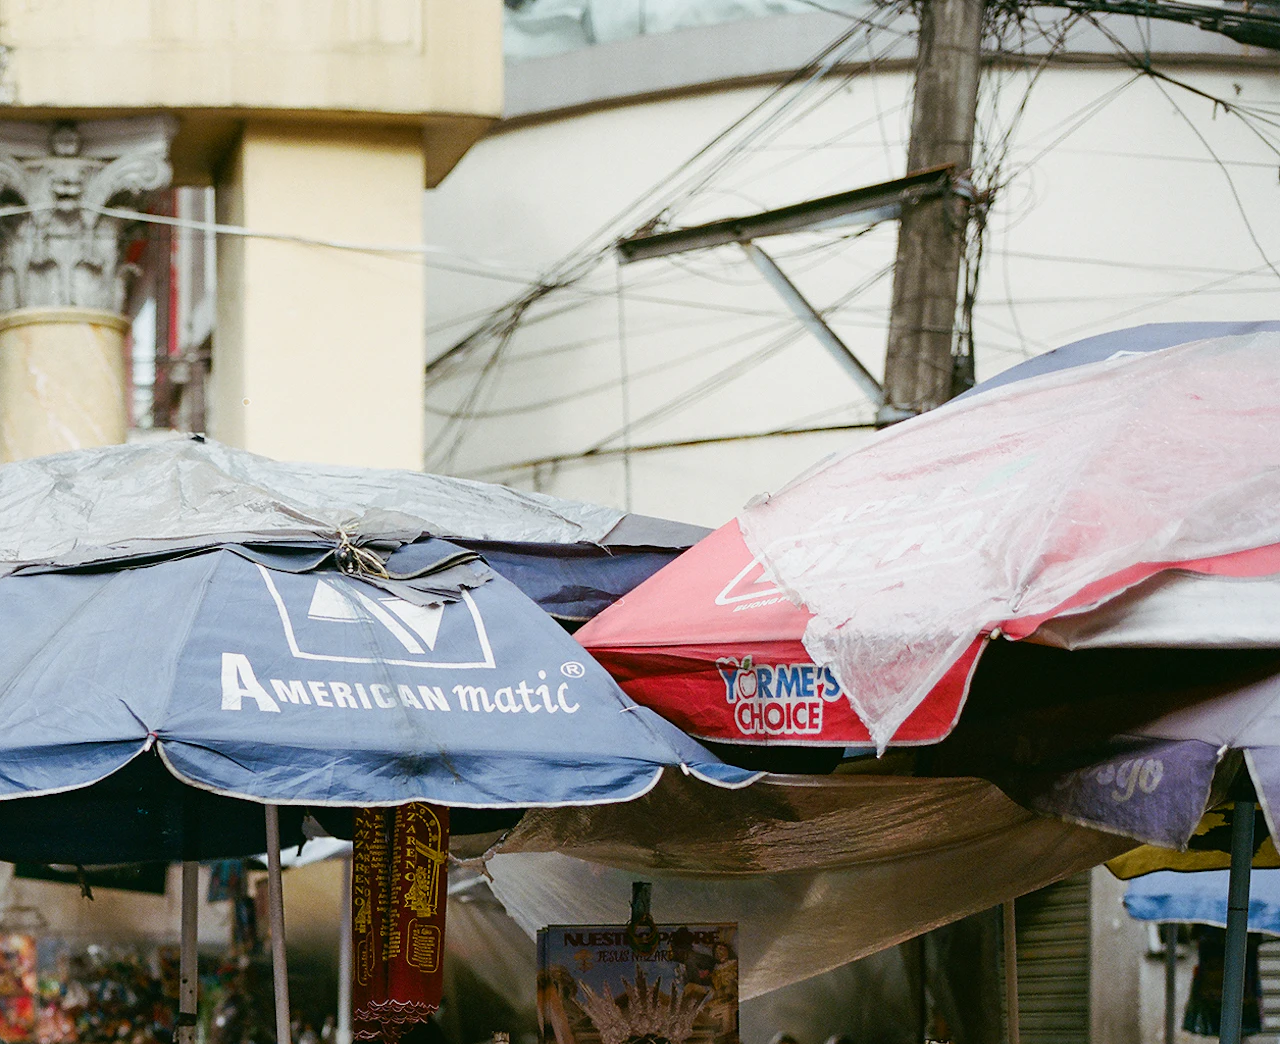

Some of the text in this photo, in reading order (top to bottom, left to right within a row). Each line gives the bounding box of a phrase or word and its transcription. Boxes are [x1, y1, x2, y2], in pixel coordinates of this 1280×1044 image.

[221, 652, 582, 715] AMERICAN matic
[737, 702, 820, 731] CHOICE
